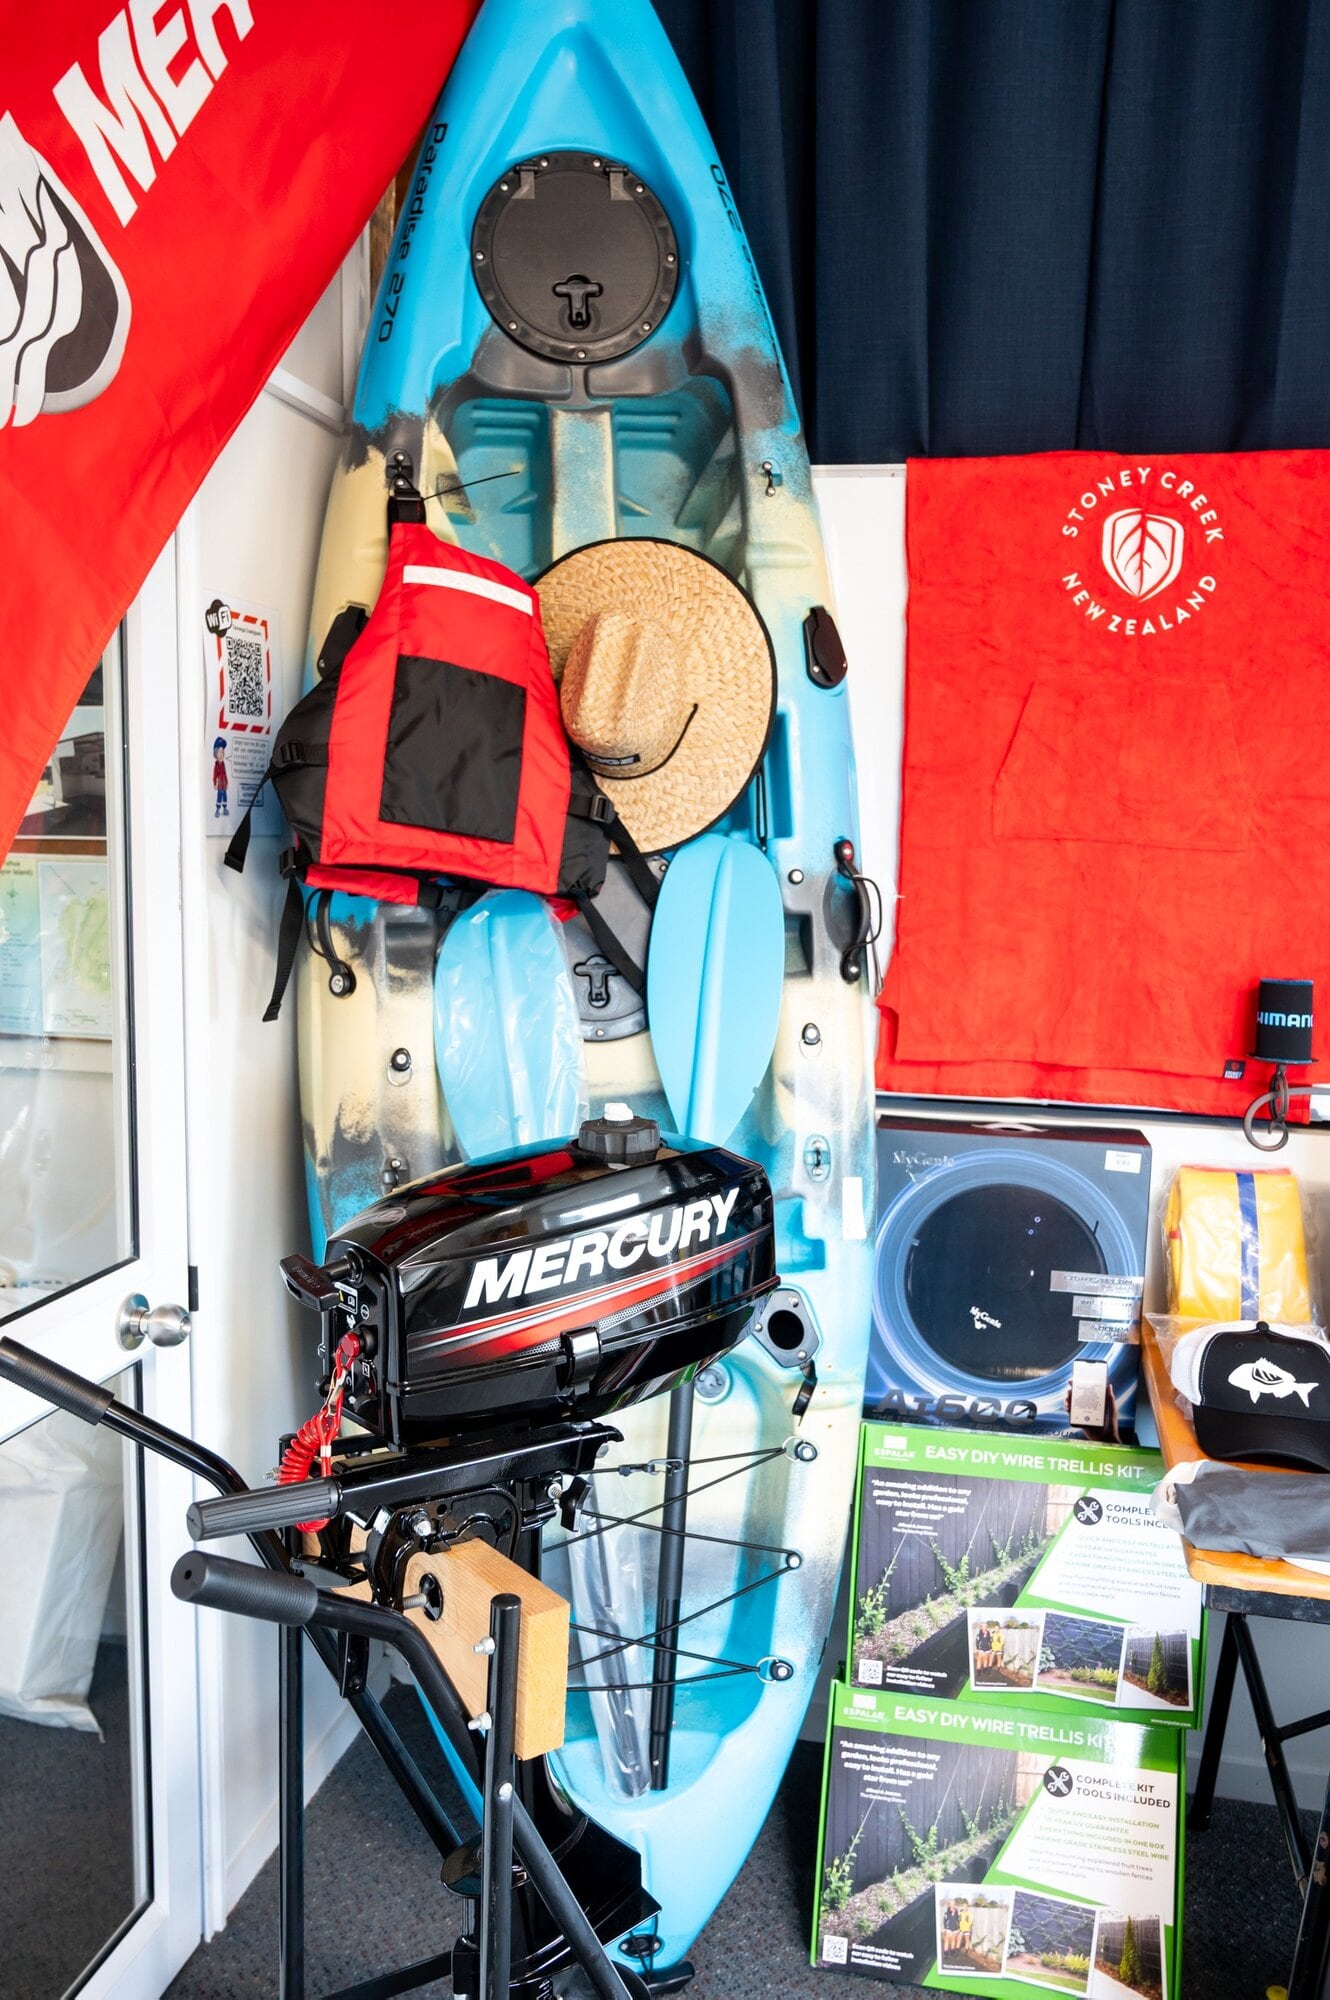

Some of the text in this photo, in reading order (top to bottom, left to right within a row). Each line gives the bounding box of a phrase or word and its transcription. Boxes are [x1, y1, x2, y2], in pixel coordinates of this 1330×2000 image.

[378, 122, 448, 343] Paradise 270
[1062, 467, 1225, 544] STONEY CREEK
[1062, 572, 1217, 636] NEW ZEALAND
[1257, 1011, 1314, 1028] HIMAN
[463, 1188, 740, 1309] MERCURY
[925, 1445, 1144, 1479] EASY DIY WIRE TRELLIS KIT
[1106, 1515, 1140, 1526] TOOLS
[1137, 1541, 1182, 1551] INSTALLATIO
[894, 1706, 938, 1724] EASY
[940, 1712, 969, 1729] DIY
[971, 1717, 1014, 1736] WIRE
[1016, 1723, 1084, 1745] TRELLIS
[1076, 1787, 1171, 1809] TOOLS INCLUDED
[1137, 1783, 1155, 1793] KIT
[1088, 1812, 1107, 1821] EASY
[1108, 1816, 1160, 1830] INSTALLATION
[1127, 1848, 1149, 1858] STEEL
[1150, 1851, 1169, 1861] WIRE
[1132, 1839, 1149, 1848] ONE
[1149, 1841, 1166, 1850] BOX
